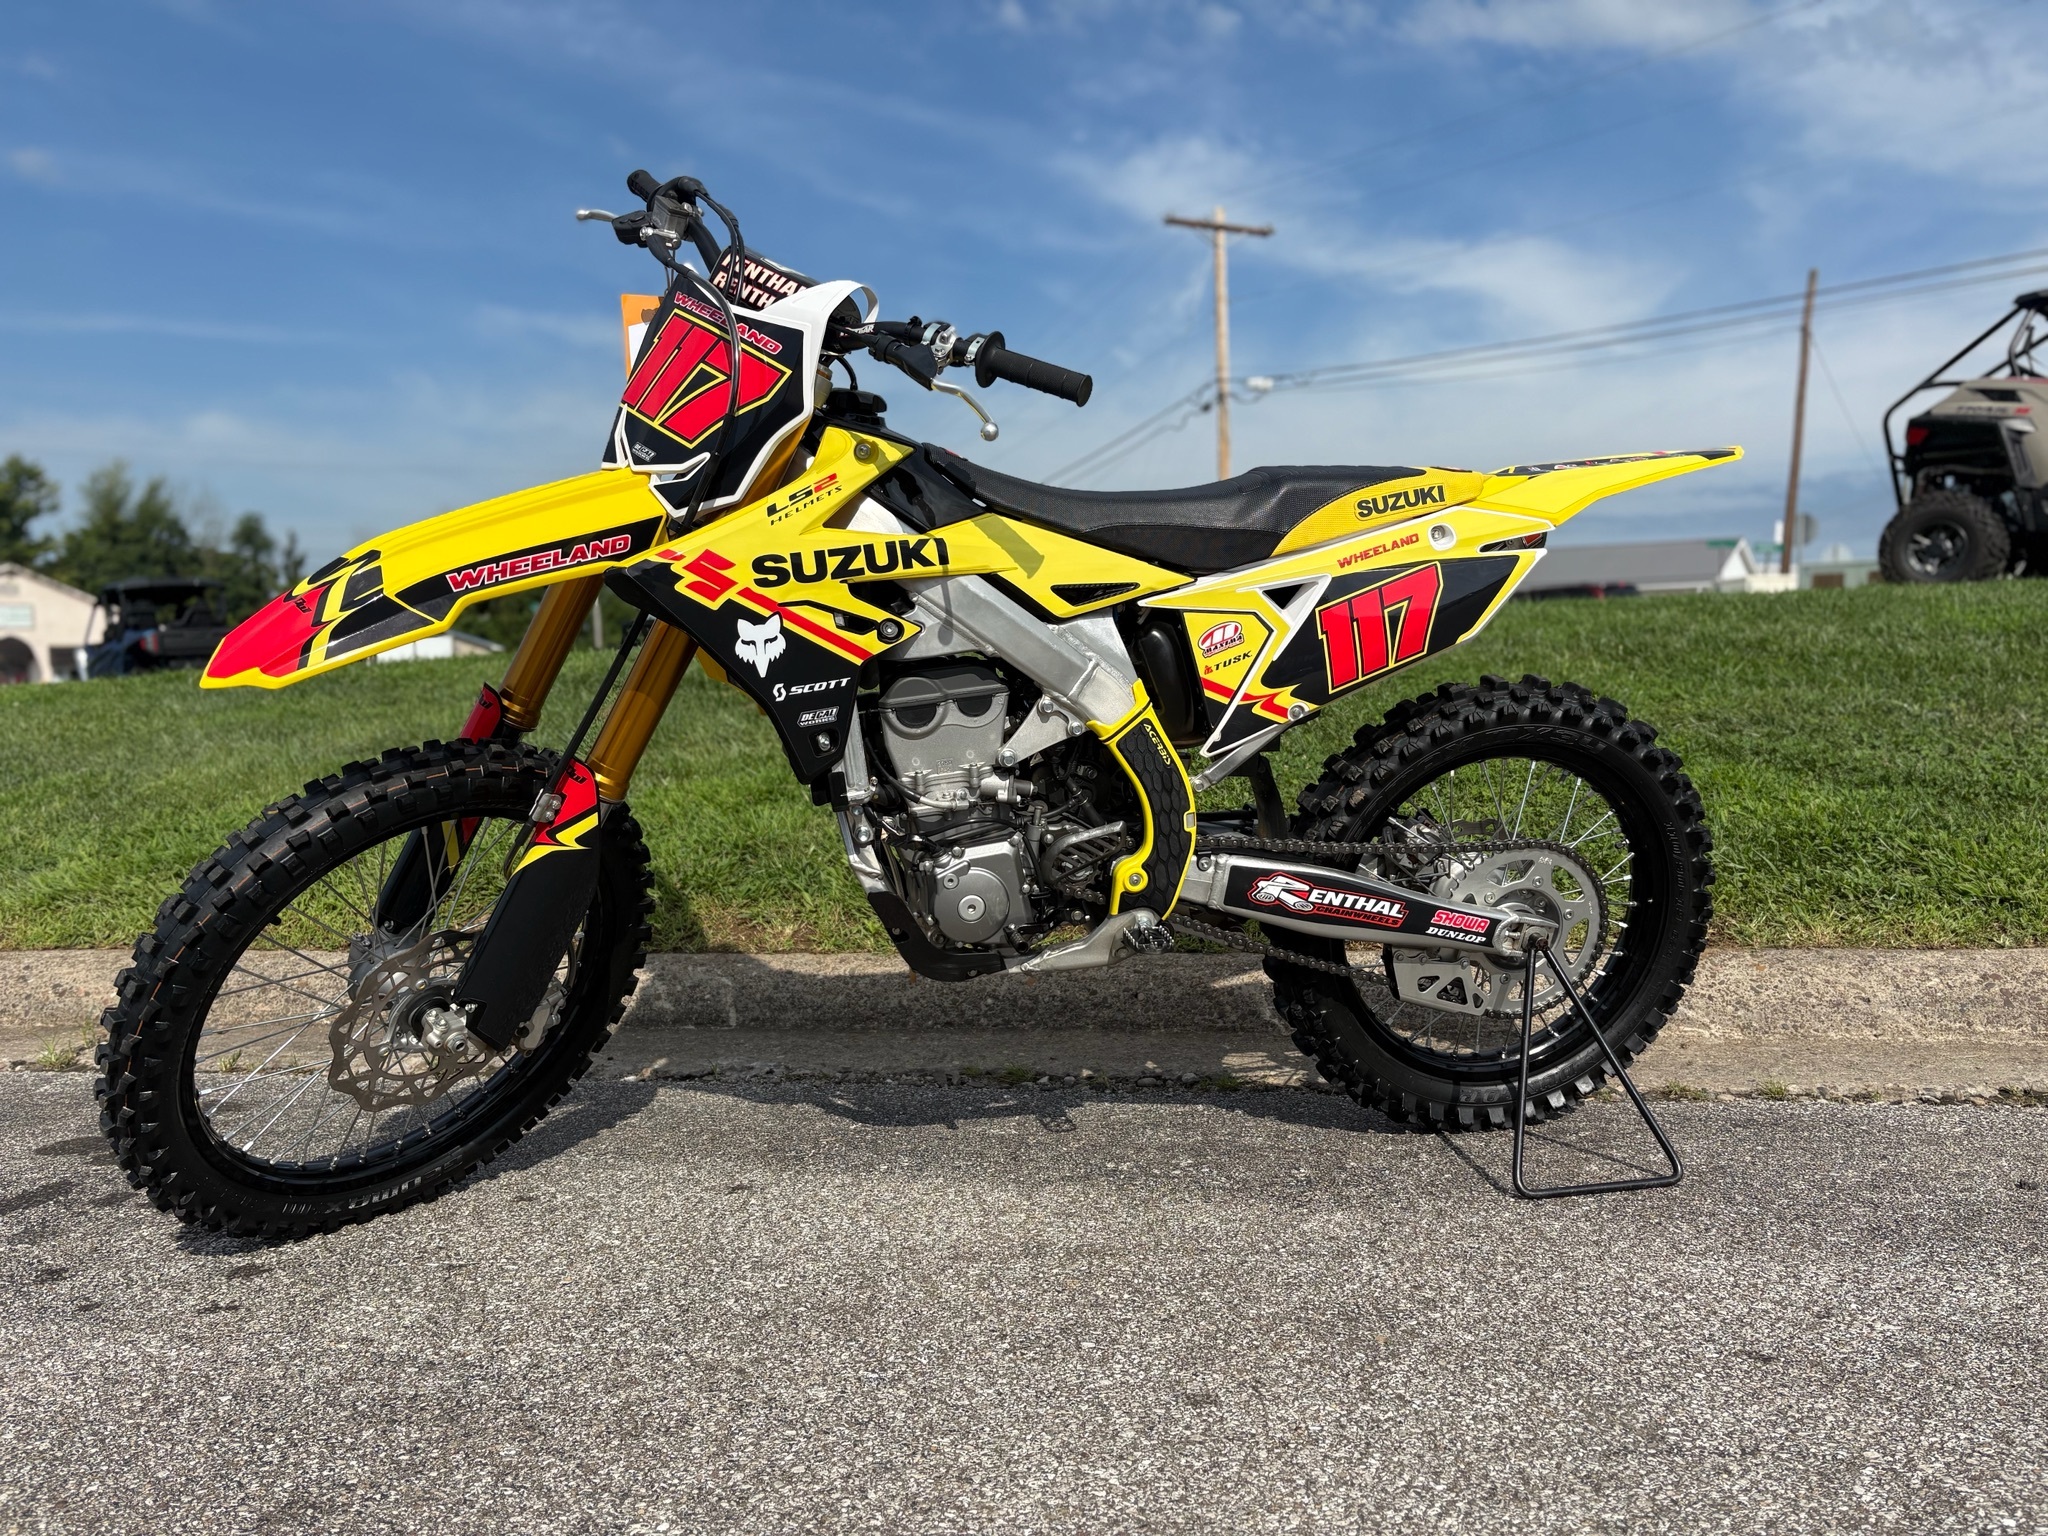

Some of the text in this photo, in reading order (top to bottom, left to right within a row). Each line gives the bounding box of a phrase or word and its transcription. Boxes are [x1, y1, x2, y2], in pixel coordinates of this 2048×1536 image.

[620, 311, 790, 446] 117
[766, 473, 839, 517] LS2
[770, 485, 842, 526] HELMETS
[1356, 485, 1446, 518] SUZUKI
[446, 535, 631, 592] WHEELAND
[751, 537, 950, 589] SUZUKI
[1337, 533, 1420, 569] WHEELAND
[1315, 561, 1443, 694] 117
[1214, 650, 1252, 671] TUSK
[788, 677, 851, 696] SCOTT
[801, 708, 838, 722] DECAL
[1251, 874, 1404, 918] RENTHAL
[1316, 905, 1401, 926] CHAINWHEELS
[1430, 909, 1490, 933] SHOWA
[1425, 926, 1487, 943] DUNLOP
